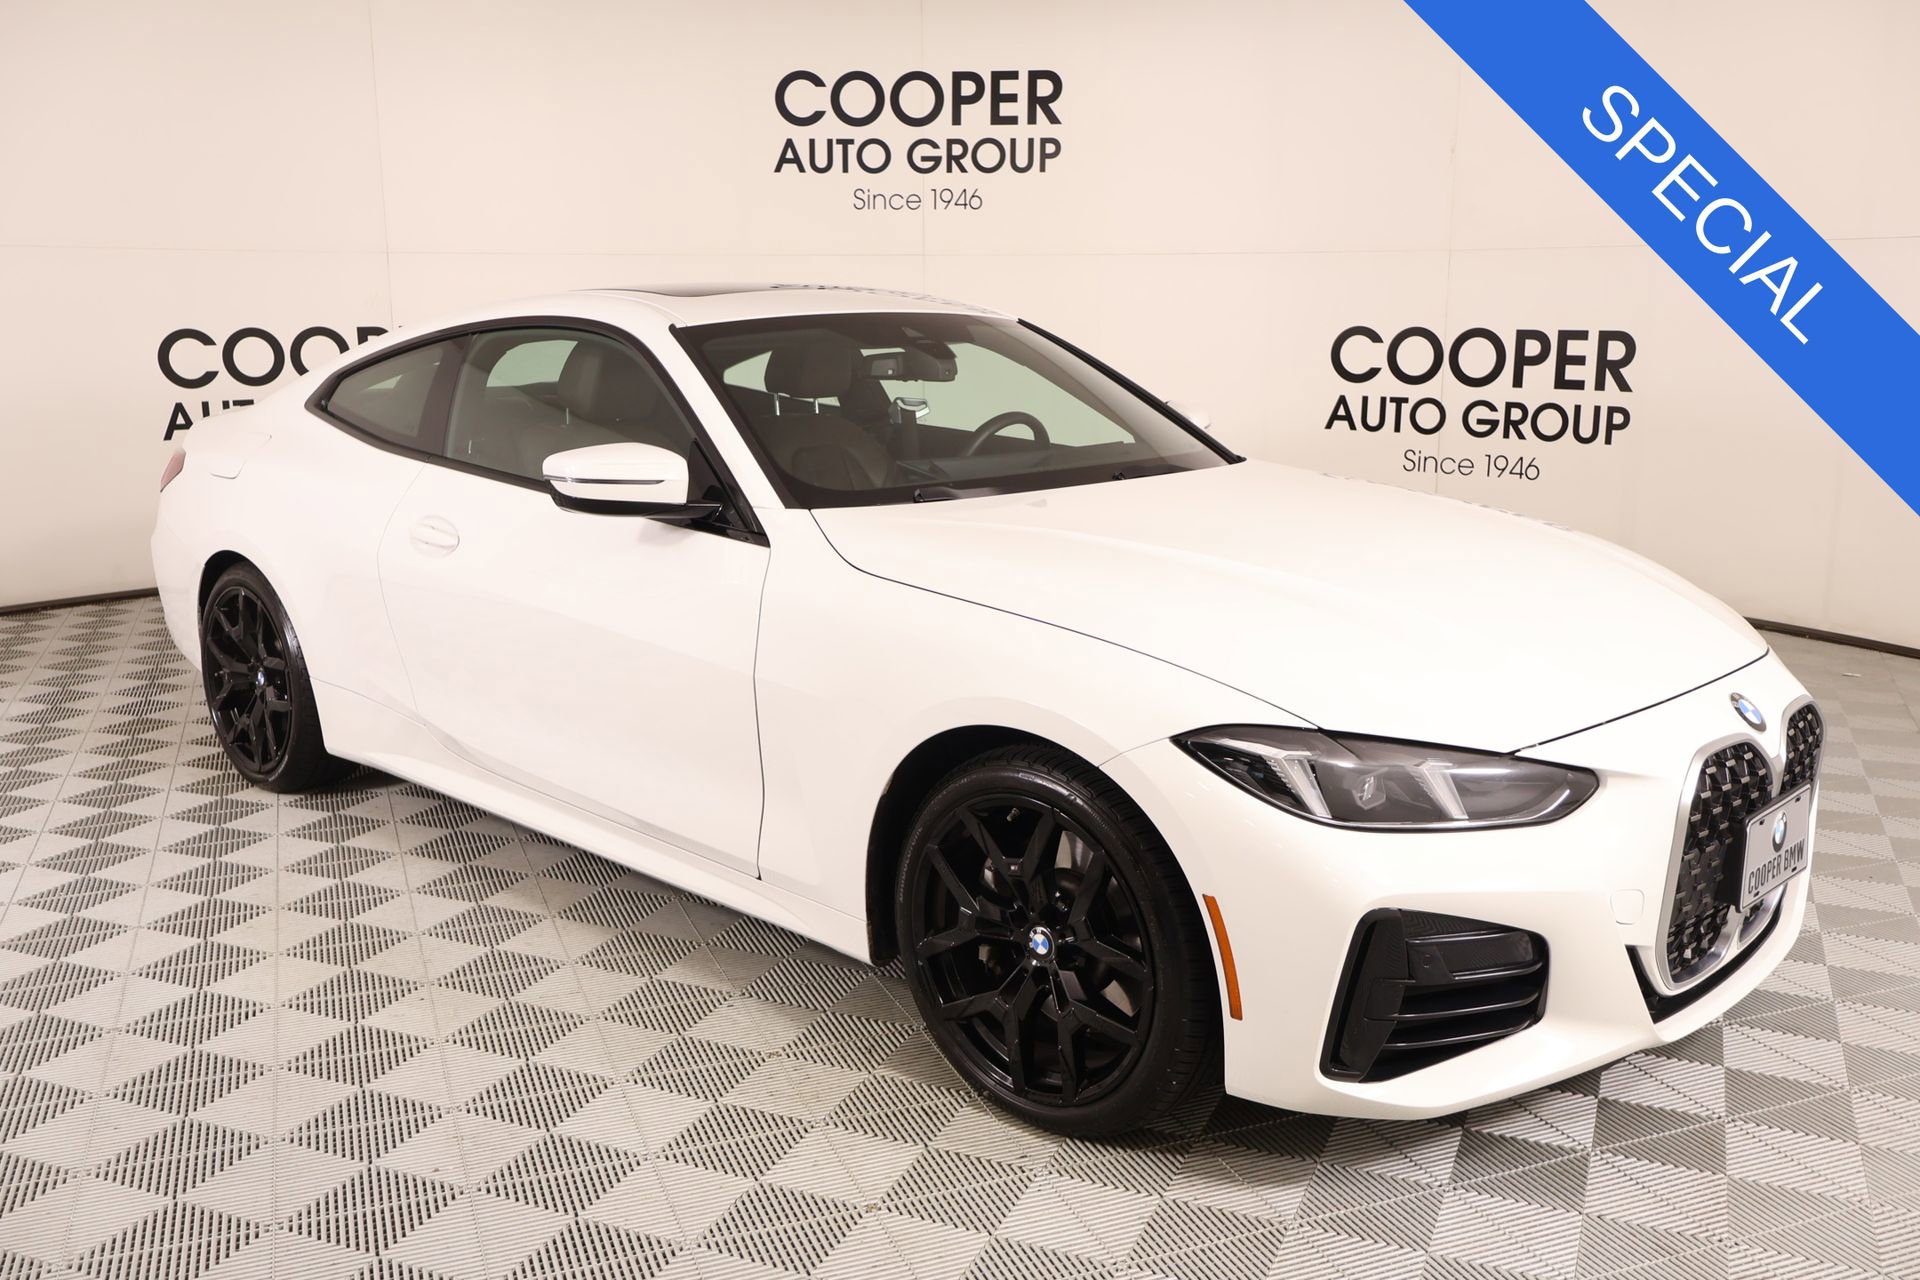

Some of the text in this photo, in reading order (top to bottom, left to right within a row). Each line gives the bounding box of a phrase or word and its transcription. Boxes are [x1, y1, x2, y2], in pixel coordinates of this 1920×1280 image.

[774, 69, 1063, 127] COOPER
[774, 137, 1062, 174] AUTO GROUP
[853, 188, 983, 210] Since 1946
[157, 326, 404, 389] COO
[1330, 325, 1637, 392] COOPER
[1324, 394, 1631, 445] AUTO GROUP
[1402, 449, 1541, 481] Since 1946
[1748, 838, 1805, 894] COOPER BMW
